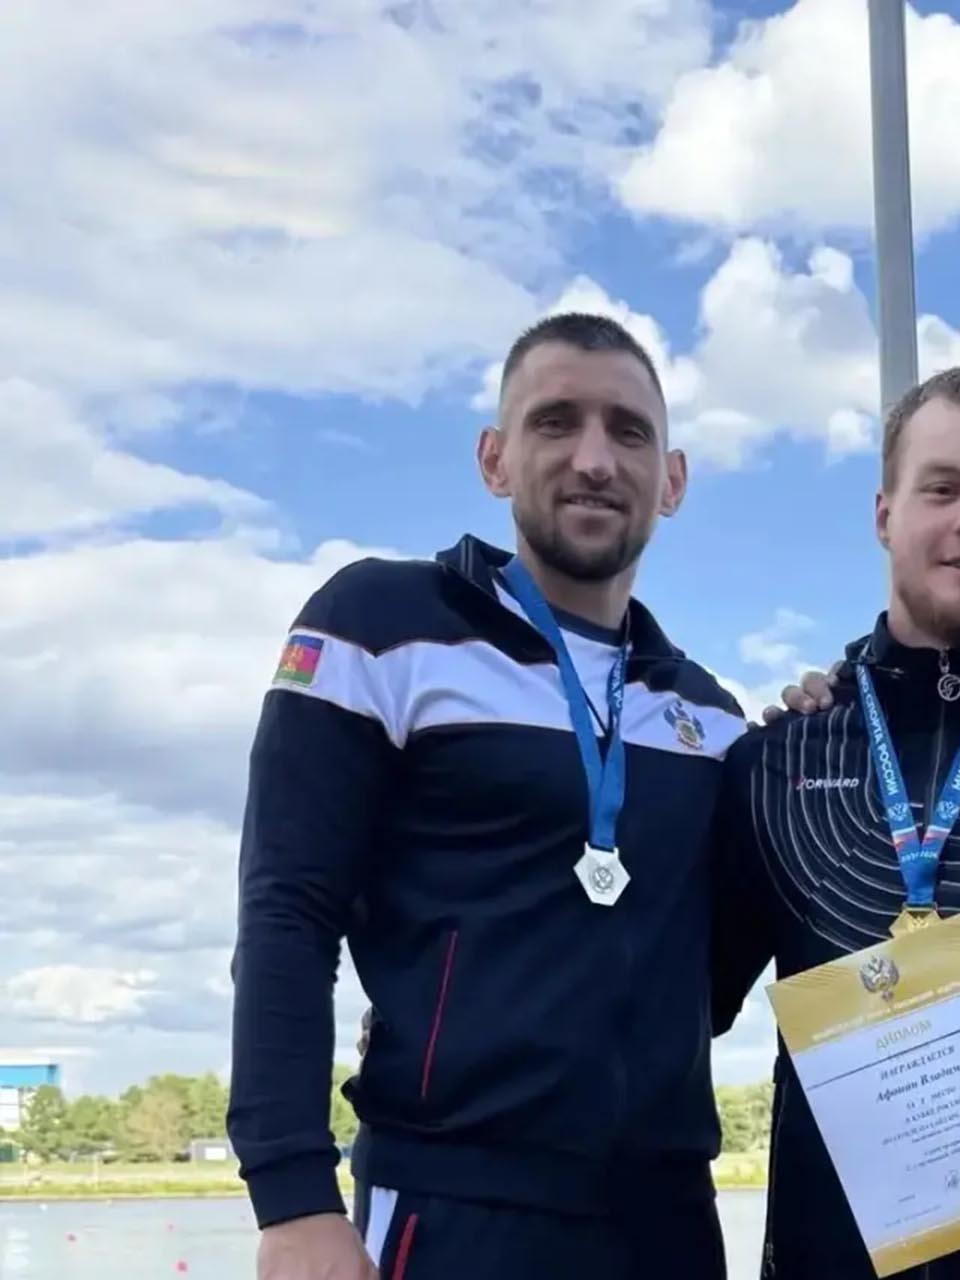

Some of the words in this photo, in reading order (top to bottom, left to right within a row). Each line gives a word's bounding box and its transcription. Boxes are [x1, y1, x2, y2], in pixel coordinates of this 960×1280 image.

[864, 695, 884, 743] СПОРТА
[876, 744, 898, 795] РОССИИ
[874, 1018, 933, 1050] ДИПЛОМ
